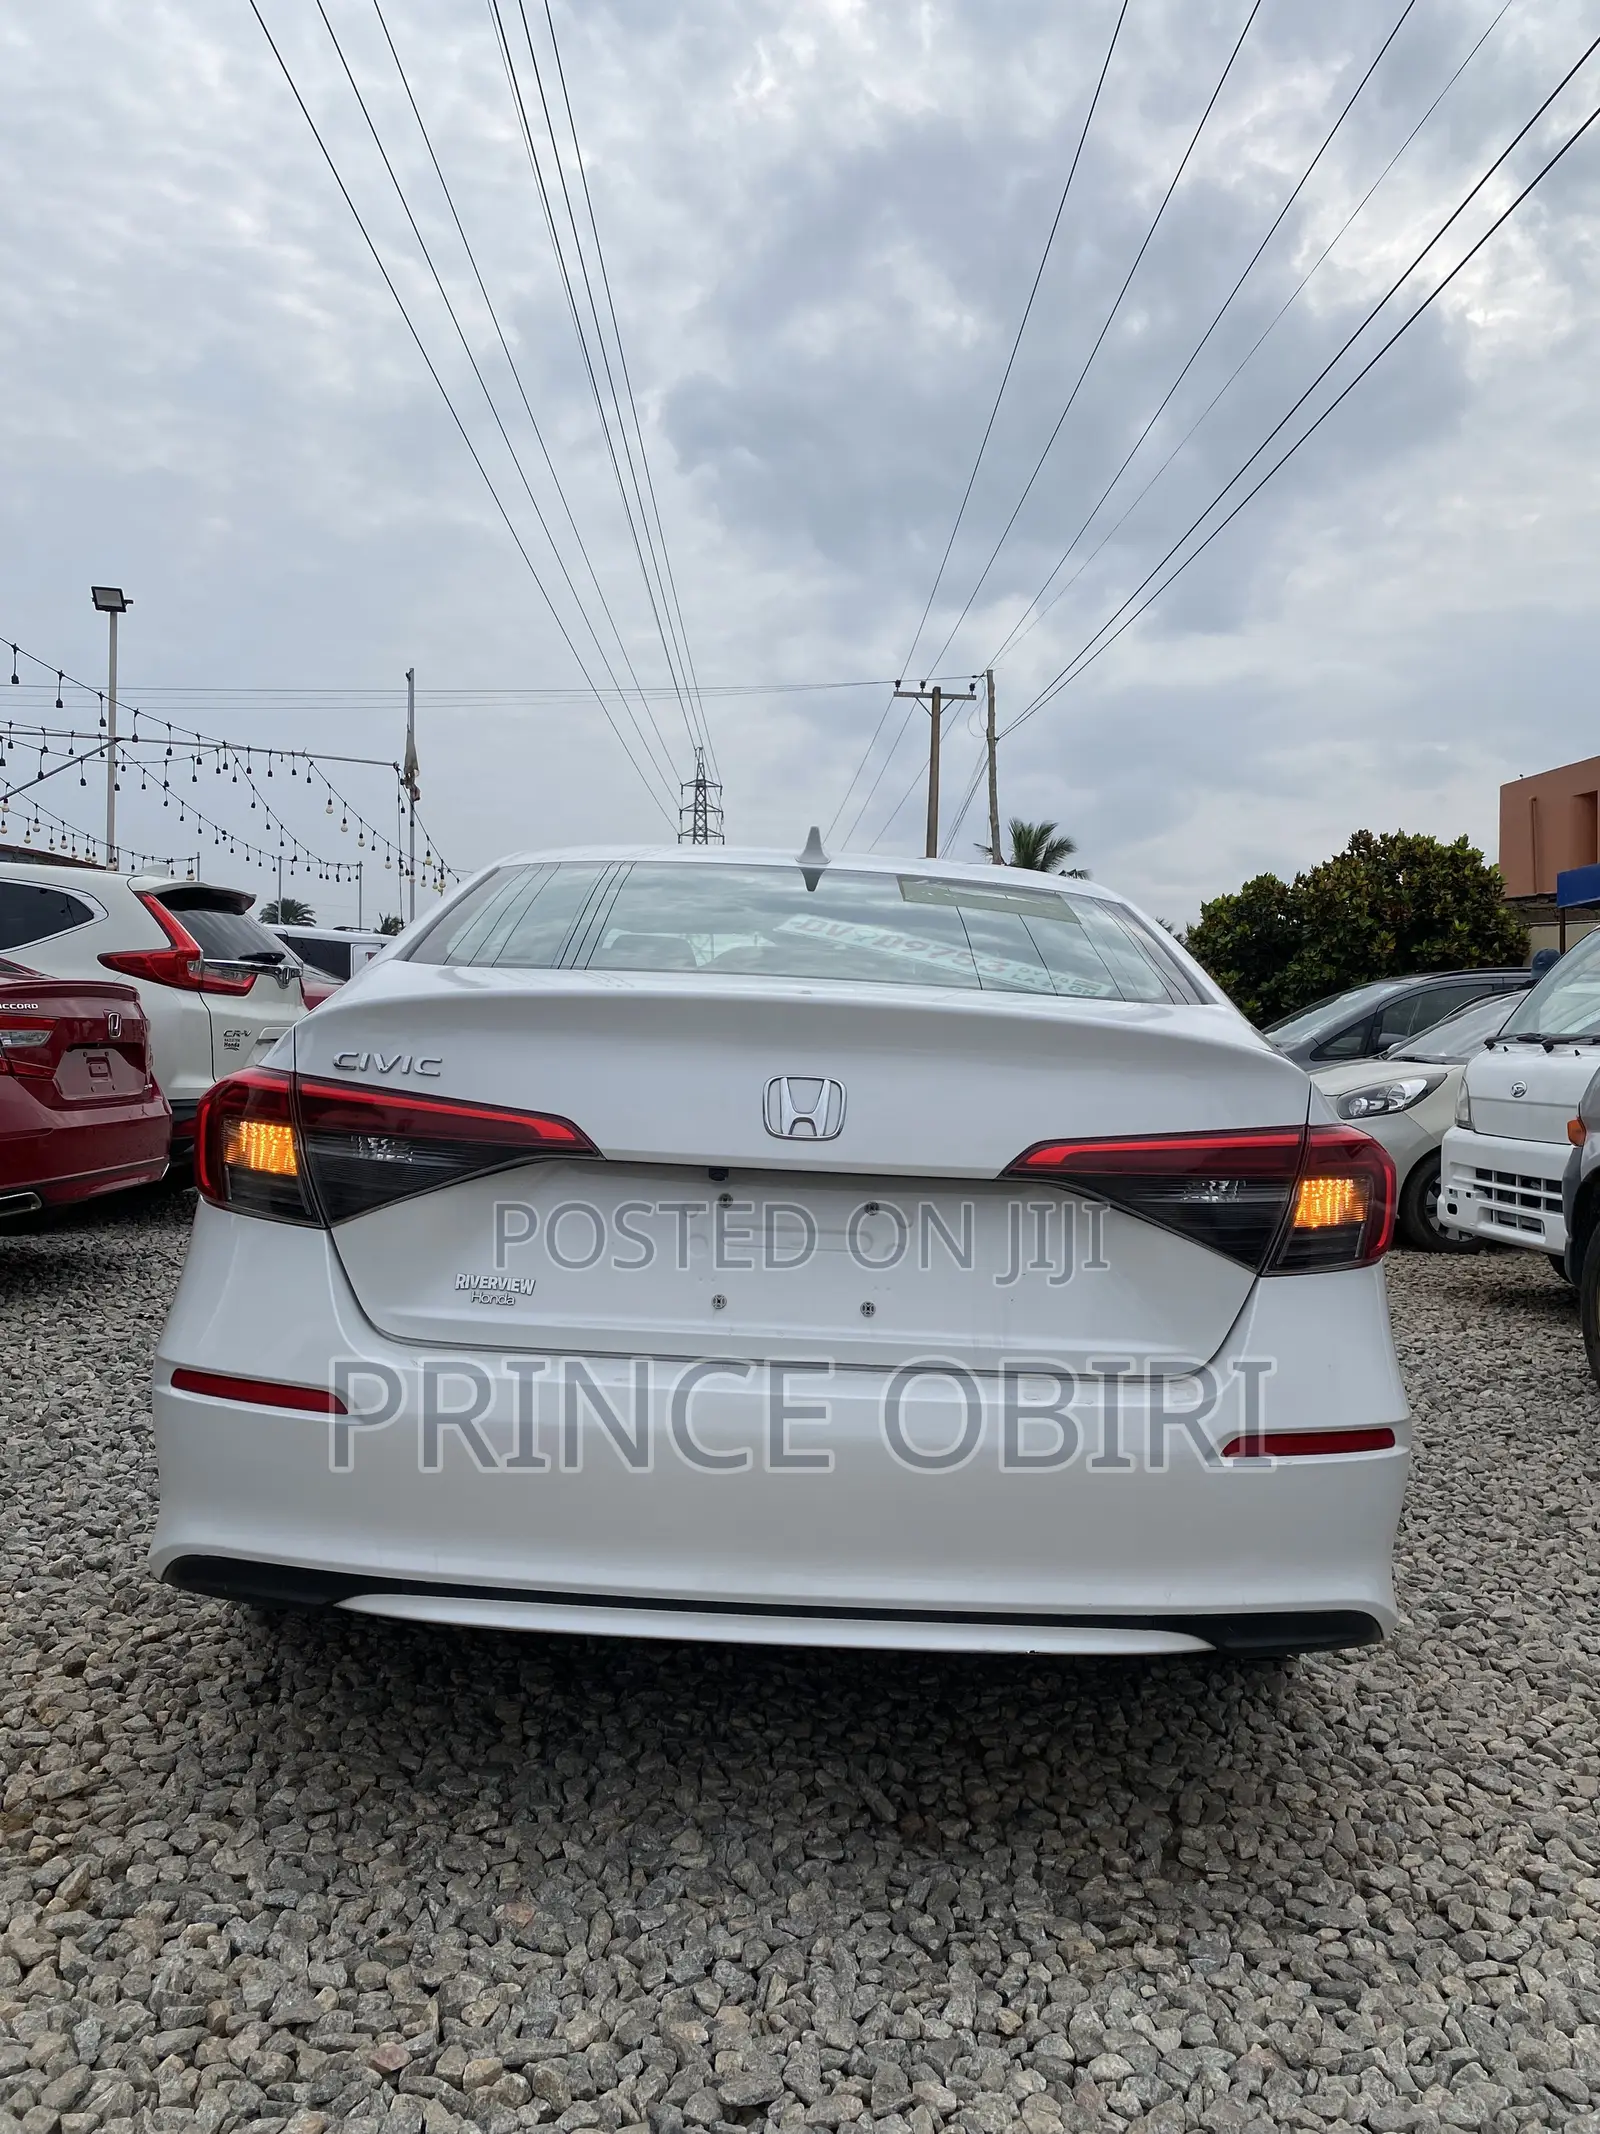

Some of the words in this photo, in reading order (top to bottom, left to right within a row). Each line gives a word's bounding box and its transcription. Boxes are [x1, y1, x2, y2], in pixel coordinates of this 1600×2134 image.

[223, 1029, 252, 1038] CR-V
[332, 1051, 442, 1077] CIVIC
[454, 1273, 536, 1296] RIVERVIEW
[470, 1290, 516, 1306] Honda
